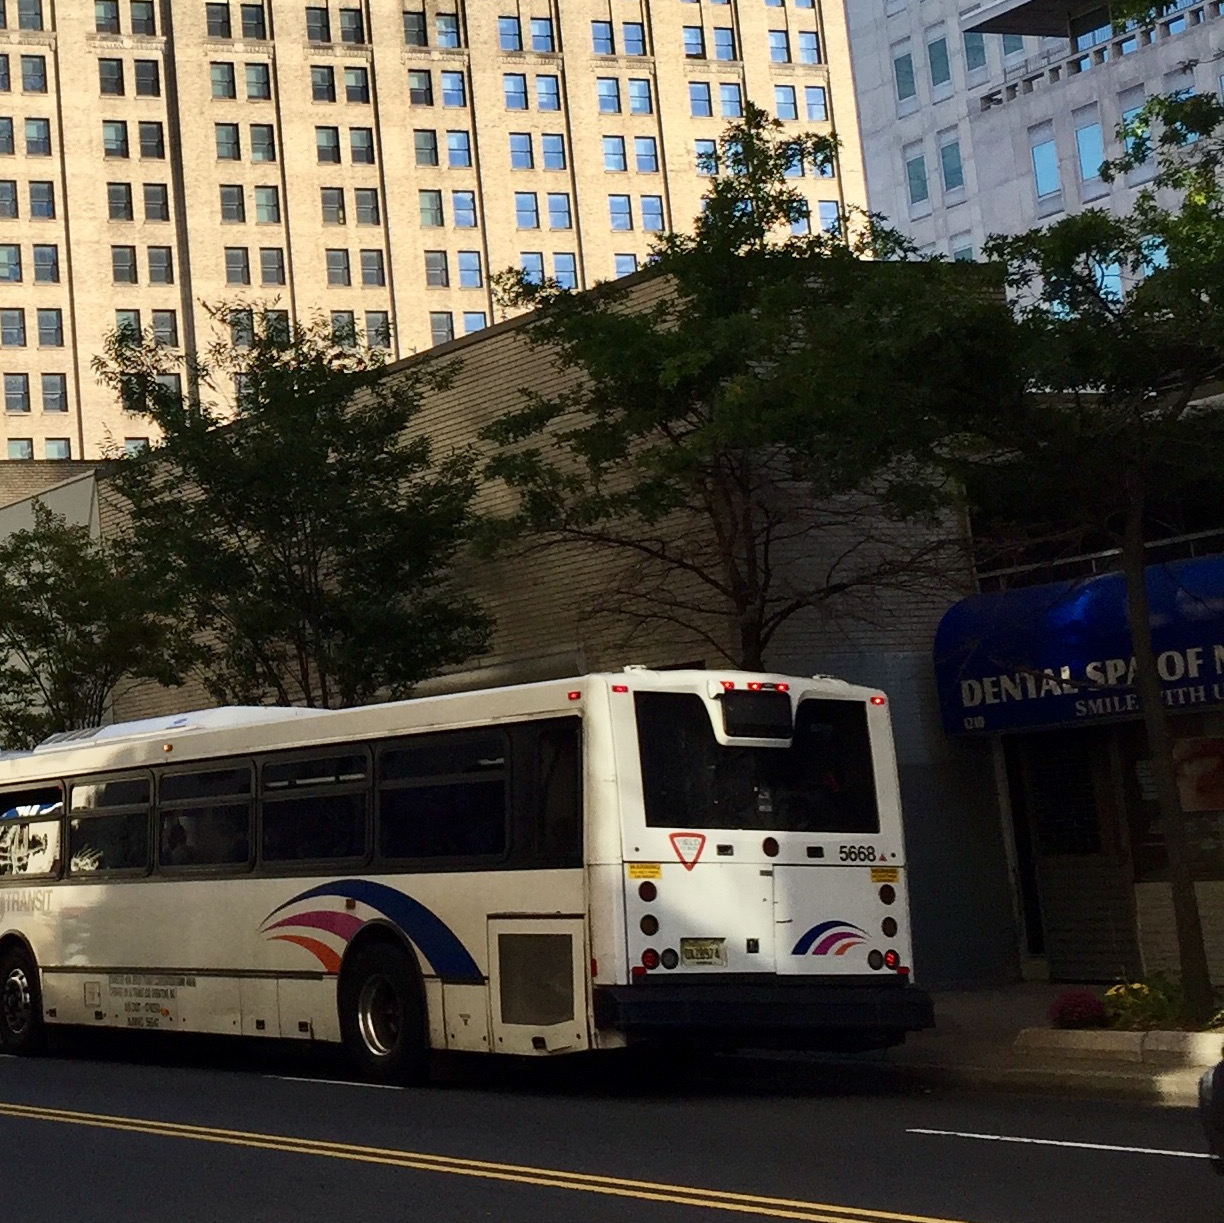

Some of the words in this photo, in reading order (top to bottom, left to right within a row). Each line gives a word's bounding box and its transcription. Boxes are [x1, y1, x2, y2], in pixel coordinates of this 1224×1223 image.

[960, 665, 1079, 708] DENTAL
[1157, 647, 1204, 681] OF
[1075, 693, 1140, 717] SMILE
[1160, 684, 1207, 707] ITH
[839, 845, 877, 862] 5668
[6, 889, 54, 912] TRANSIT
